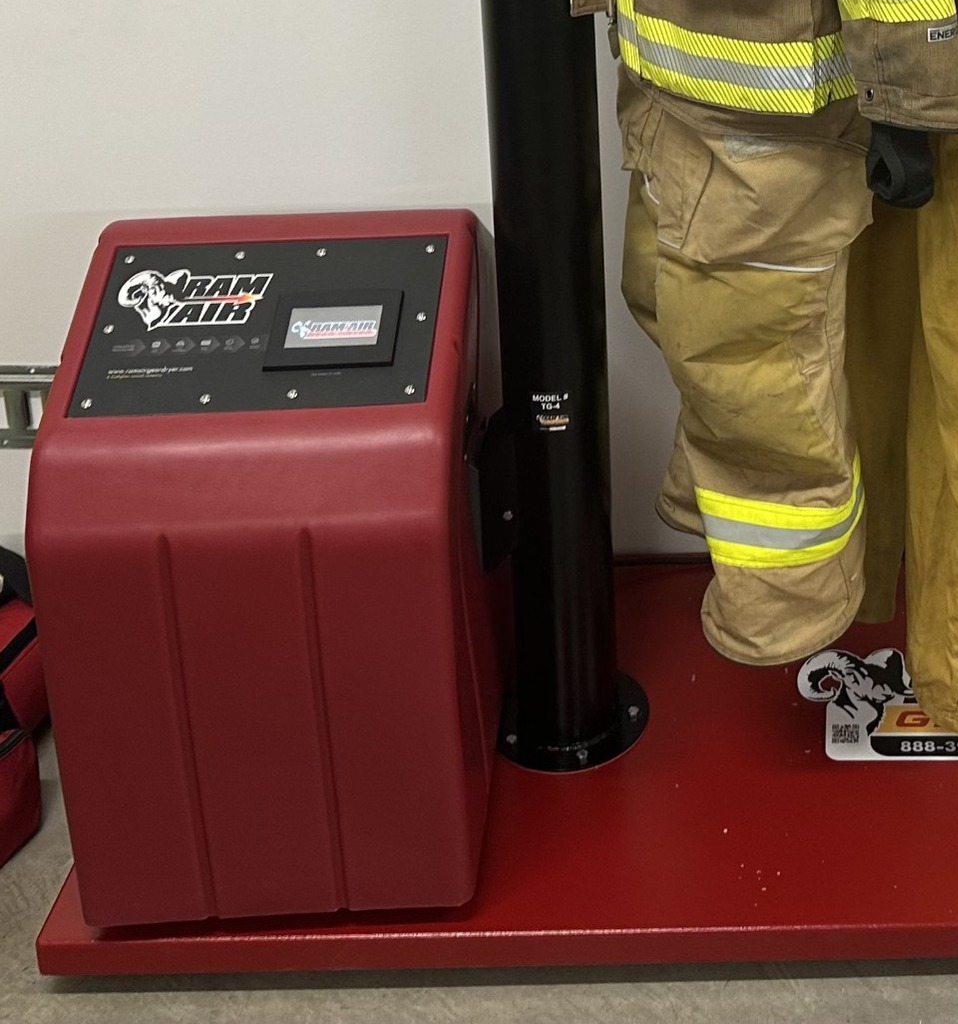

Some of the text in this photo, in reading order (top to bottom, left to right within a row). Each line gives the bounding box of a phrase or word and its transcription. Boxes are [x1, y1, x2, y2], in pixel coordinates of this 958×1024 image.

[184, 273, 274, 299] RAM
[169, 302, 255, 324] AIR
[541, 402, 560, 410] TG-4
